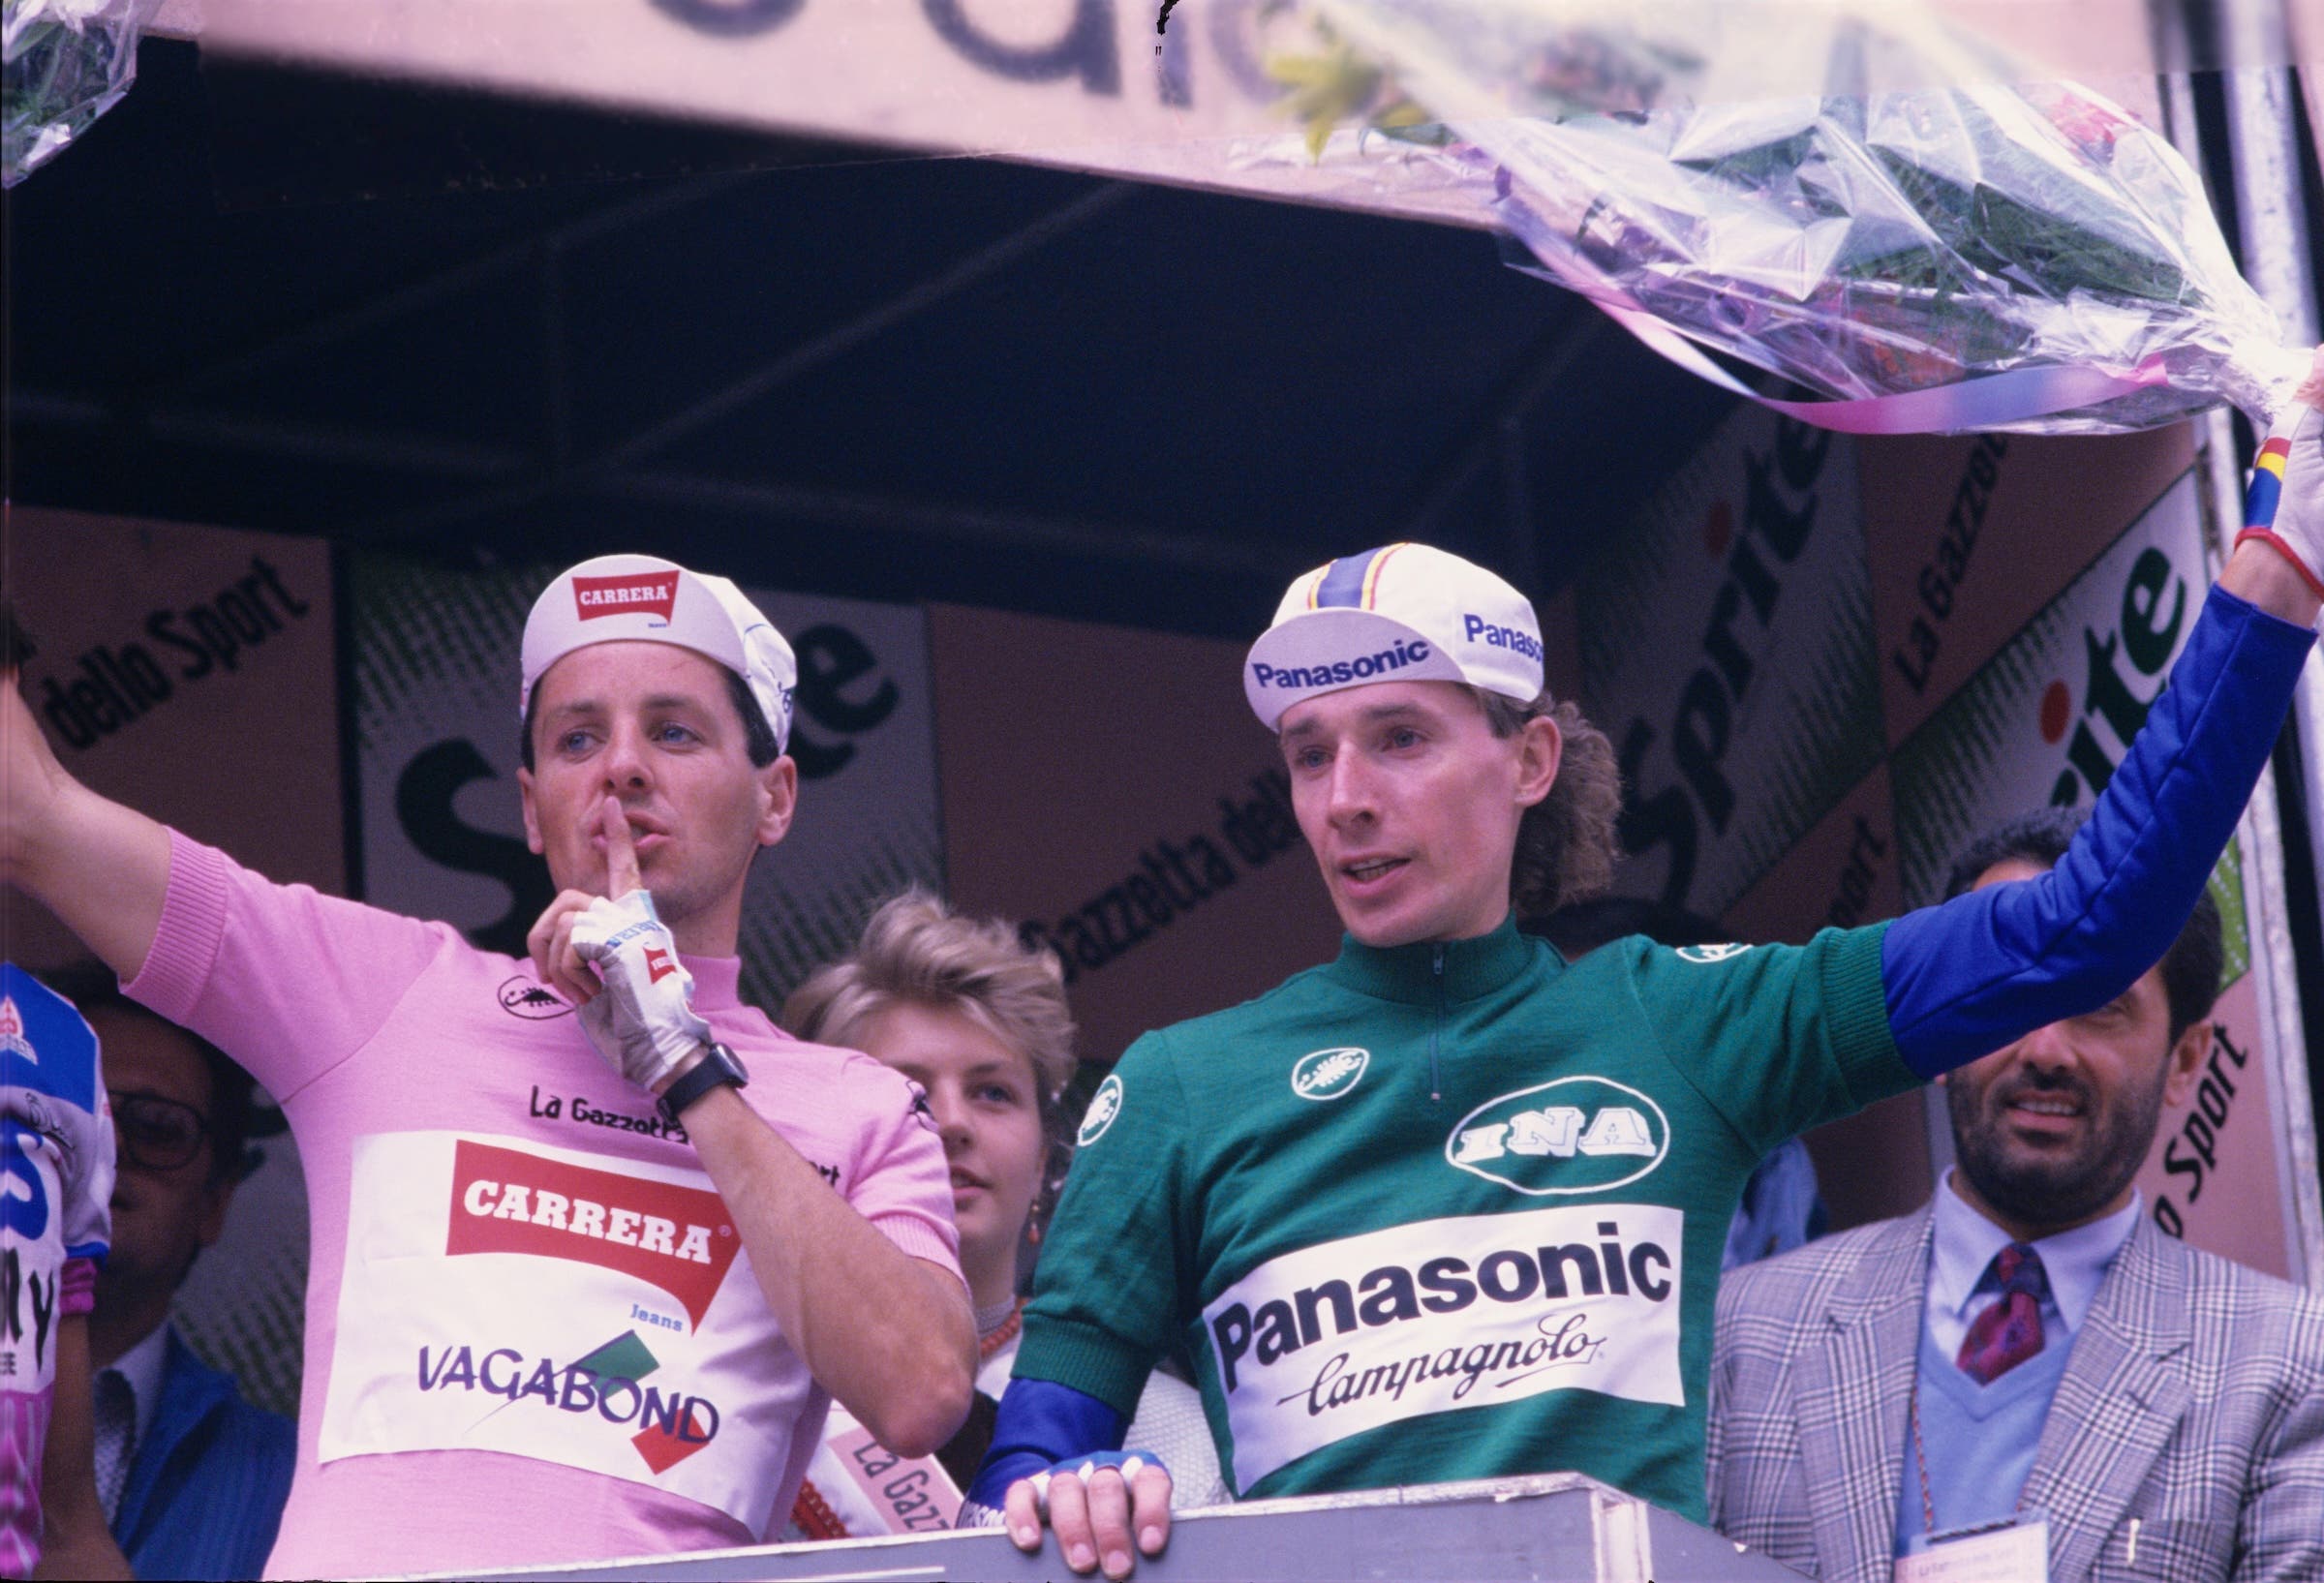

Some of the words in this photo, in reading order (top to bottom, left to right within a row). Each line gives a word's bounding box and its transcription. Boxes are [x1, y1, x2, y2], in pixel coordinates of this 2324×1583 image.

[580, 585, 669, 605] CARRERA
[42, 645, 172, 749] dello
[146, 554, 309, 680] Sport
[1252, 639, 1430, 688] Panasonic
[530, 1084, 563, 1119] La
[1454, 1107, 1657, 1162] INA
[2164, 1021, 2248, 1204] Sport
[464, 1179, 712, 1264] CARRERA
[630, 1303, 684, 1332] Jeans
[1211, 1221, 1672, 1393] Panasonic
[419, 1345, 720, 1444] VAGABOND
[1276, 1313, 1607, 1416] Campagnolo
